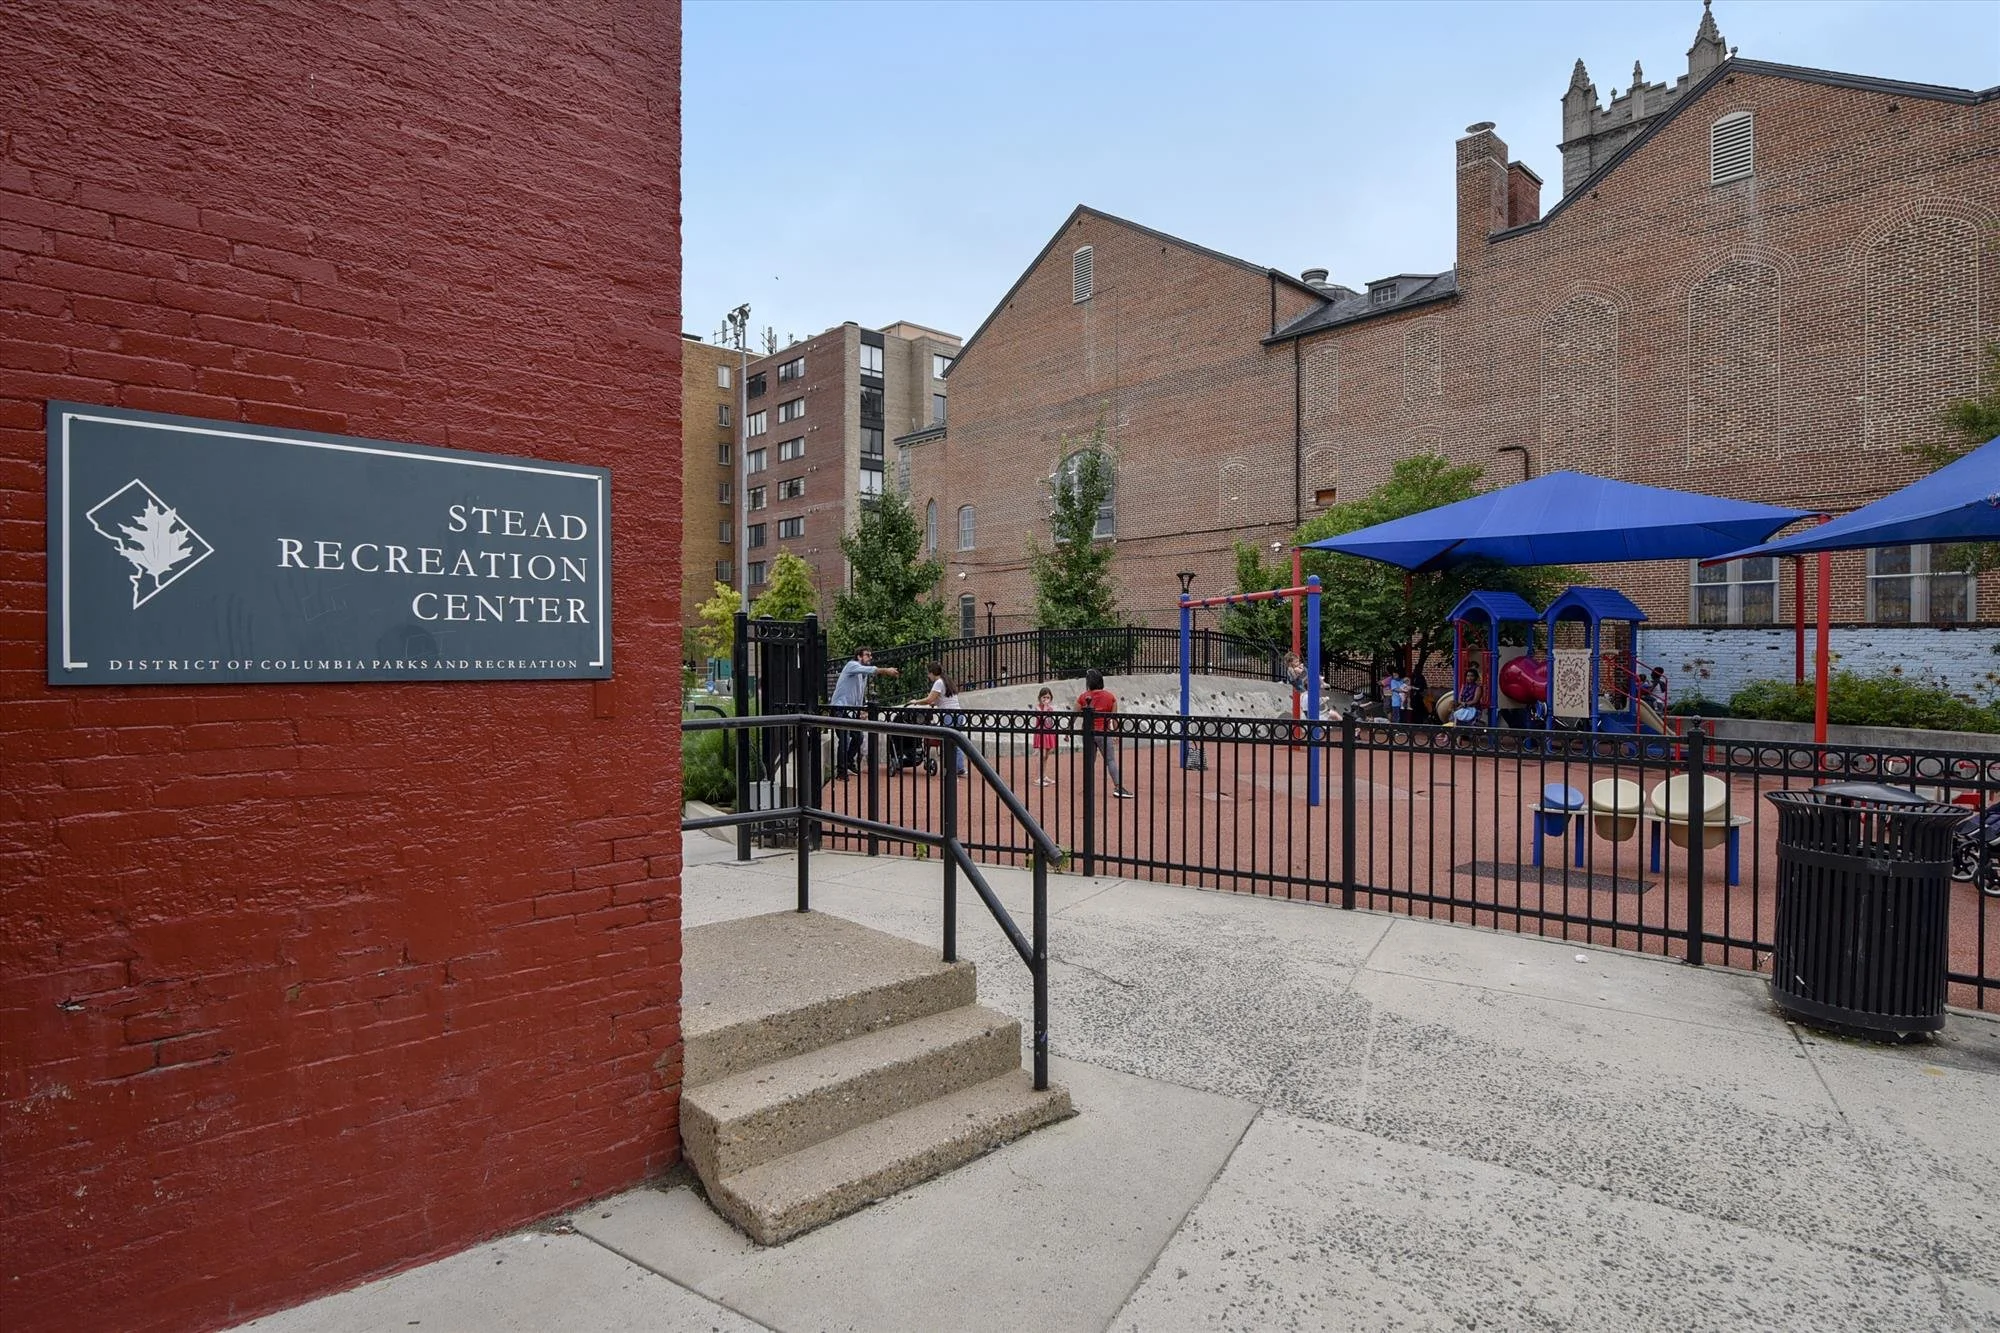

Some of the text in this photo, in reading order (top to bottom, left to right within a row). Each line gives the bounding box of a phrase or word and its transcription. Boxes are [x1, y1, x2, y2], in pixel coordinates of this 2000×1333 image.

[448, 504, 588, 541] STEAD
[277, 537, 588, 583] RECREATION
[412, 592, 590, 624] CENTER
[108, 659, 578, 670] DISTRICT OF COLUMBIA PARKS AND RECREATION
